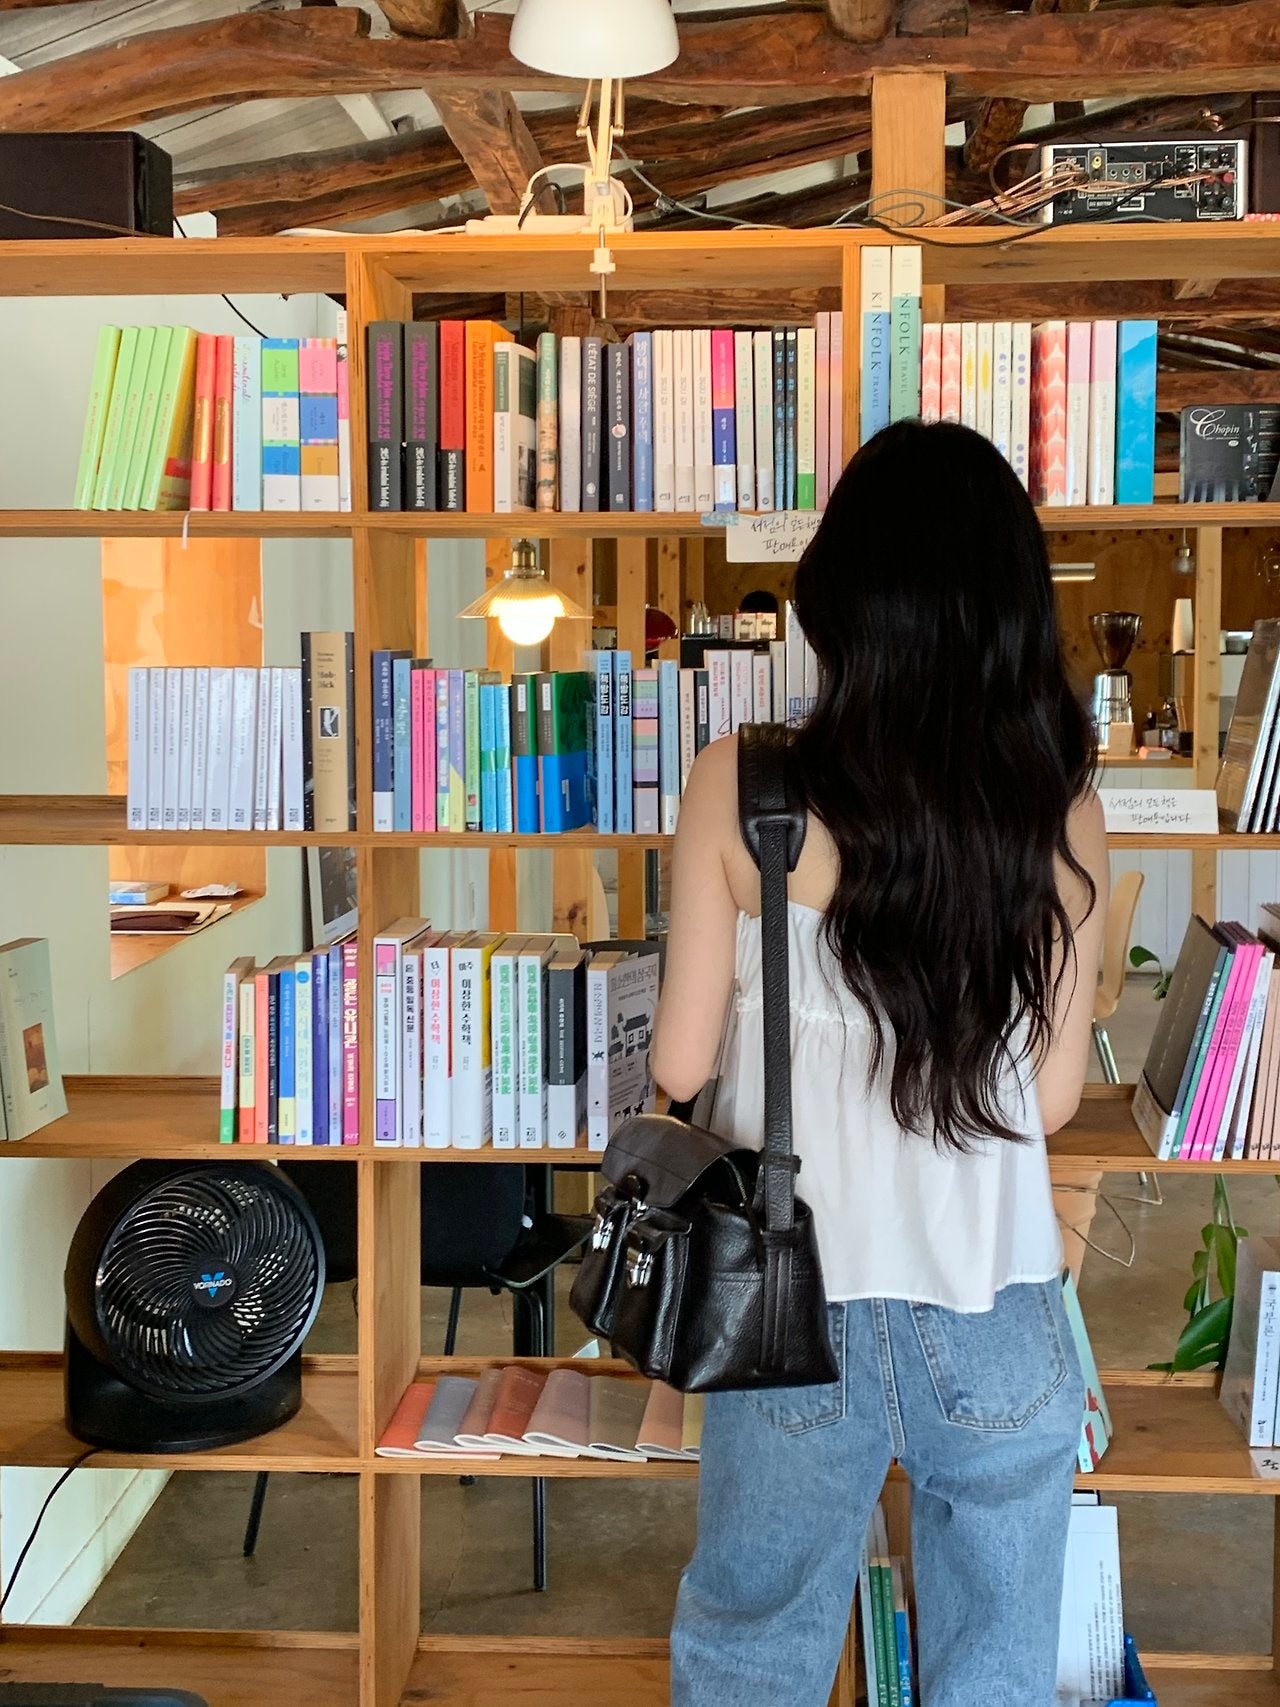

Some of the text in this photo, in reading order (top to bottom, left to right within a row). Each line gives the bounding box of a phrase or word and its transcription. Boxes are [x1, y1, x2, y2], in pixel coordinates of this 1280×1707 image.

[871, 292, 882, 408] KINFOLK TRAVEL
[587, 372, 596, 384] DE
[586, 386, 596, 412] SIÈGE
[1190, 409, 1240, 437] Chopin
